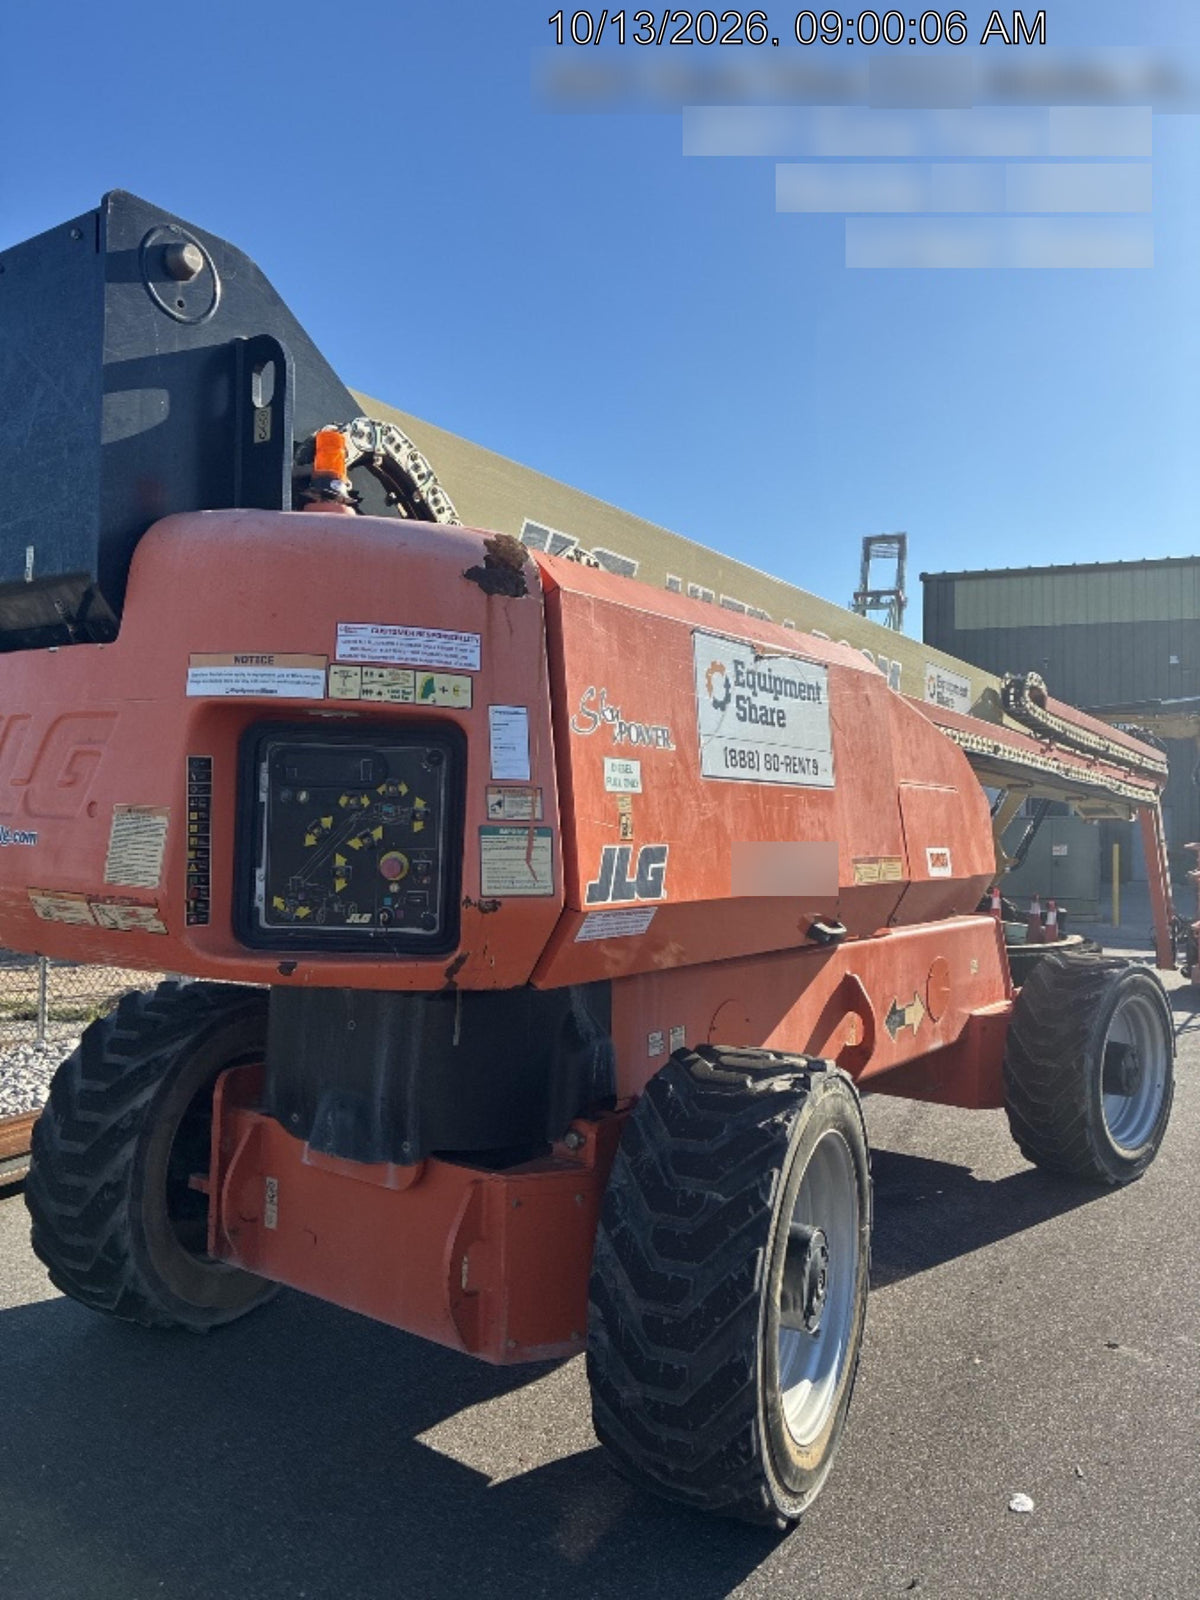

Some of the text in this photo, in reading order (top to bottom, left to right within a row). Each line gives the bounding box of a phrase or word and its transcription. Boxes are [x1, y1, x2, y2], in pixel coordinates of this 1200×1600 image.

[233, 655, 275, 666] NOTICE
[733, 659, 823, 705] Equipment
[735, 694, 787, 728] Share
[613, 720, 676, 751] POWER
[724, 746, 760, 772] (888)
[585, 845, 670, 906] JLG
[346, 913, 373, 924] JLG
